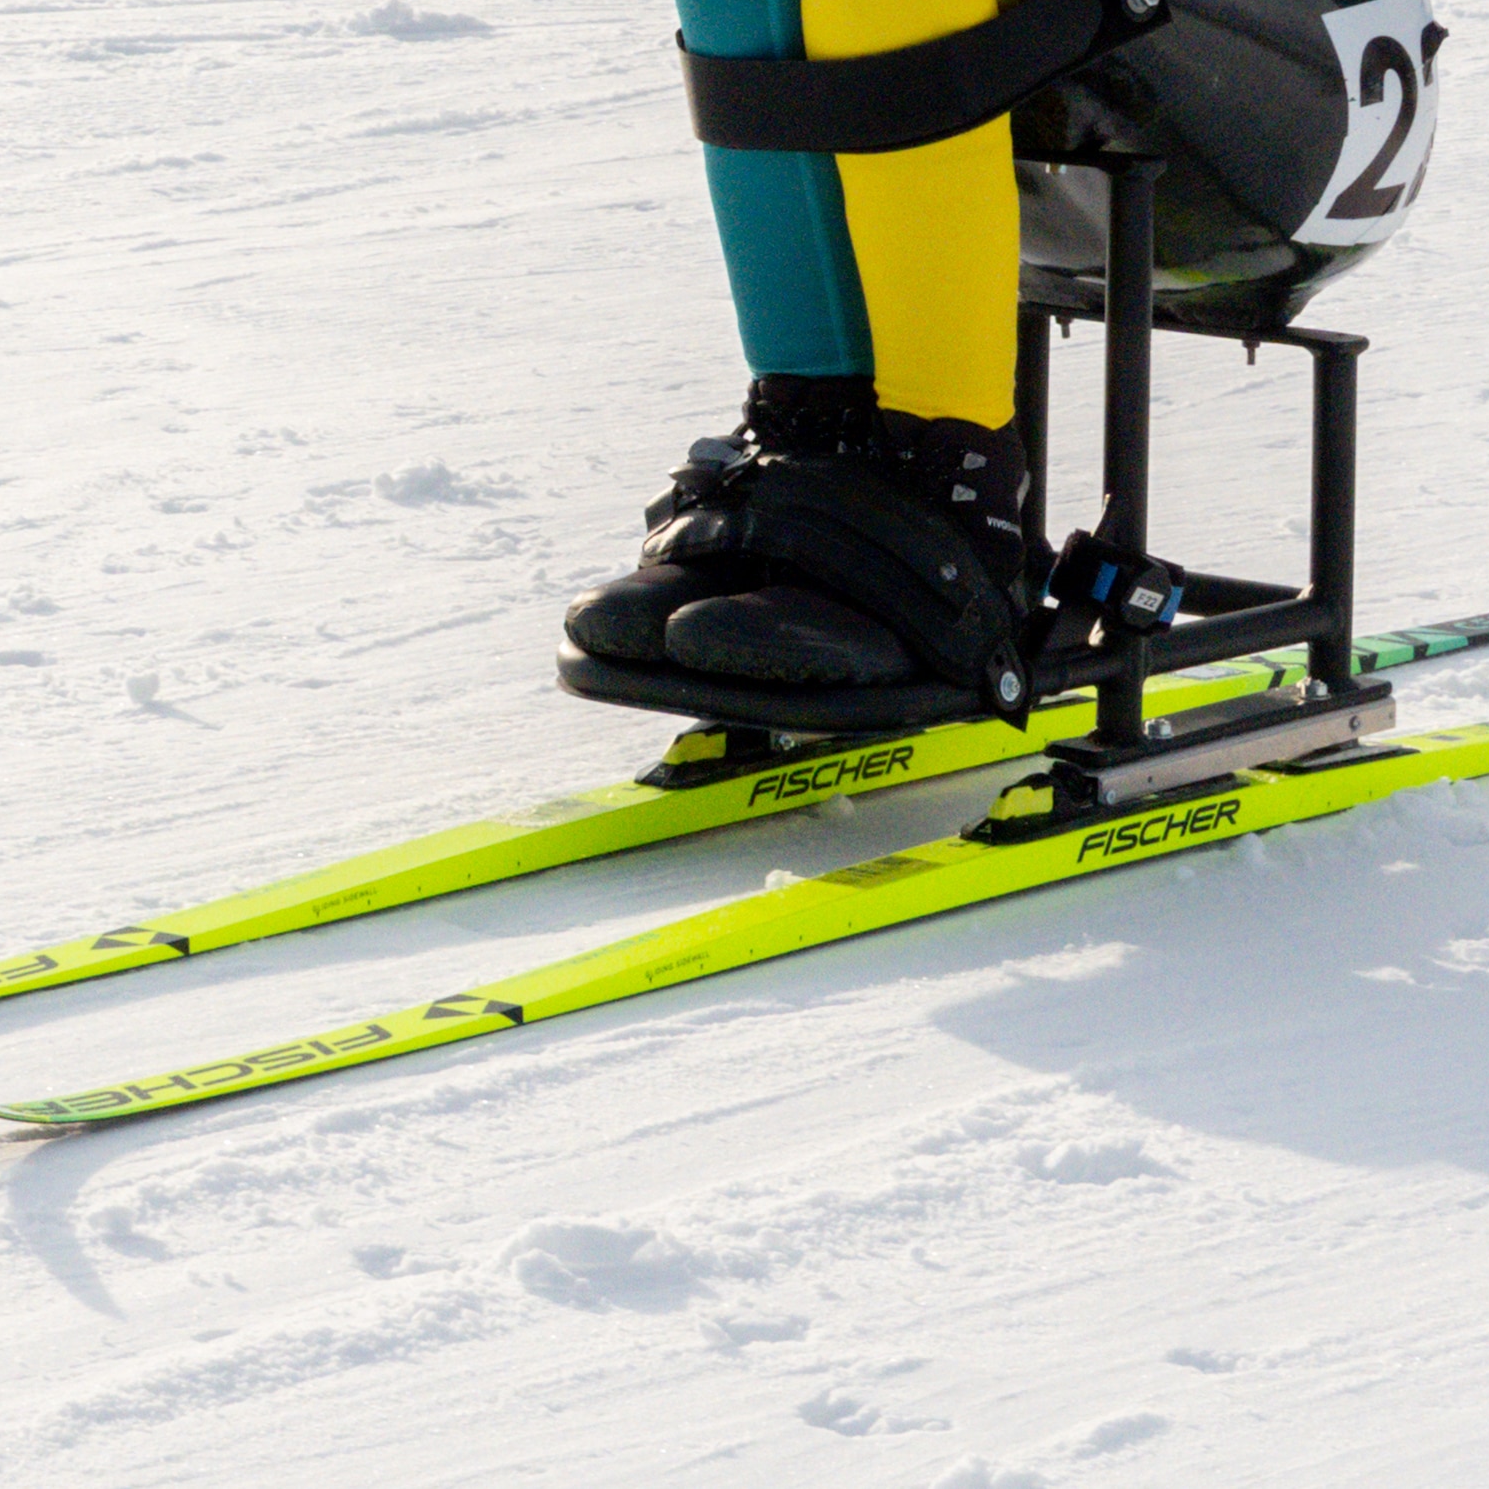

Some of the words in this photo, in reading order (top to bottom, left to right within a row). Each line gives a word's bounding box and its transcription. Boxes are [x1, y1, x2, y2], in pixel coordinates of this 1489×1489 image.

[1136, 592, 1159, 609] F22
[747, 745, 914, 807] FISCHER
[1077, 798, 1241, 864] FISCHER
